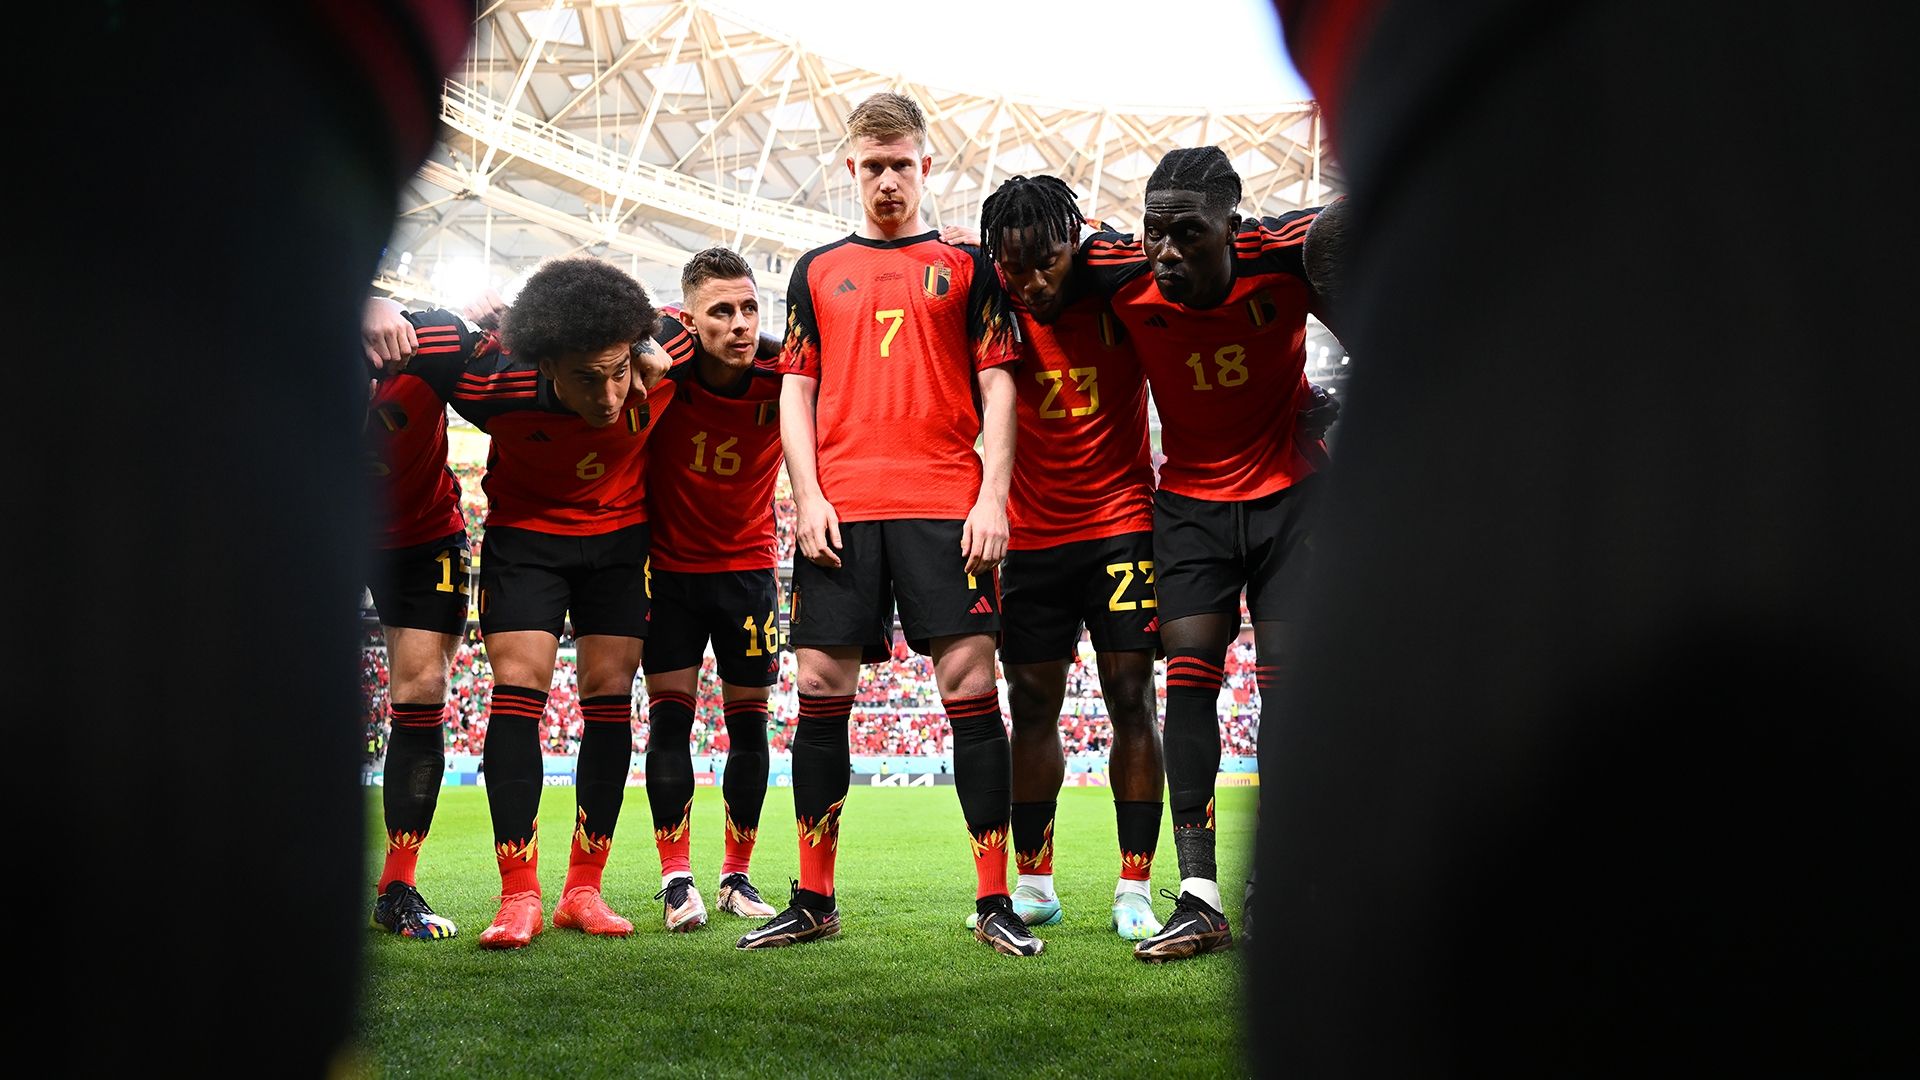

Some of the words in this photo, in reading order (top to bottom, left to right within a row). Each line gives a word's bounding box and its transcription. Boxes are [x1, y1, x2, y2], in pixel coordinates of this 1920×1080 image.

[875, 309, 904, 357] 7
[1185, 344, 1249, 391] 18
[1035, 366, 1099, 419] 23
[576, 452, 605, 480] 6
[689, 432, 741, 476] 16
[743, 611, 778, 657] 16
